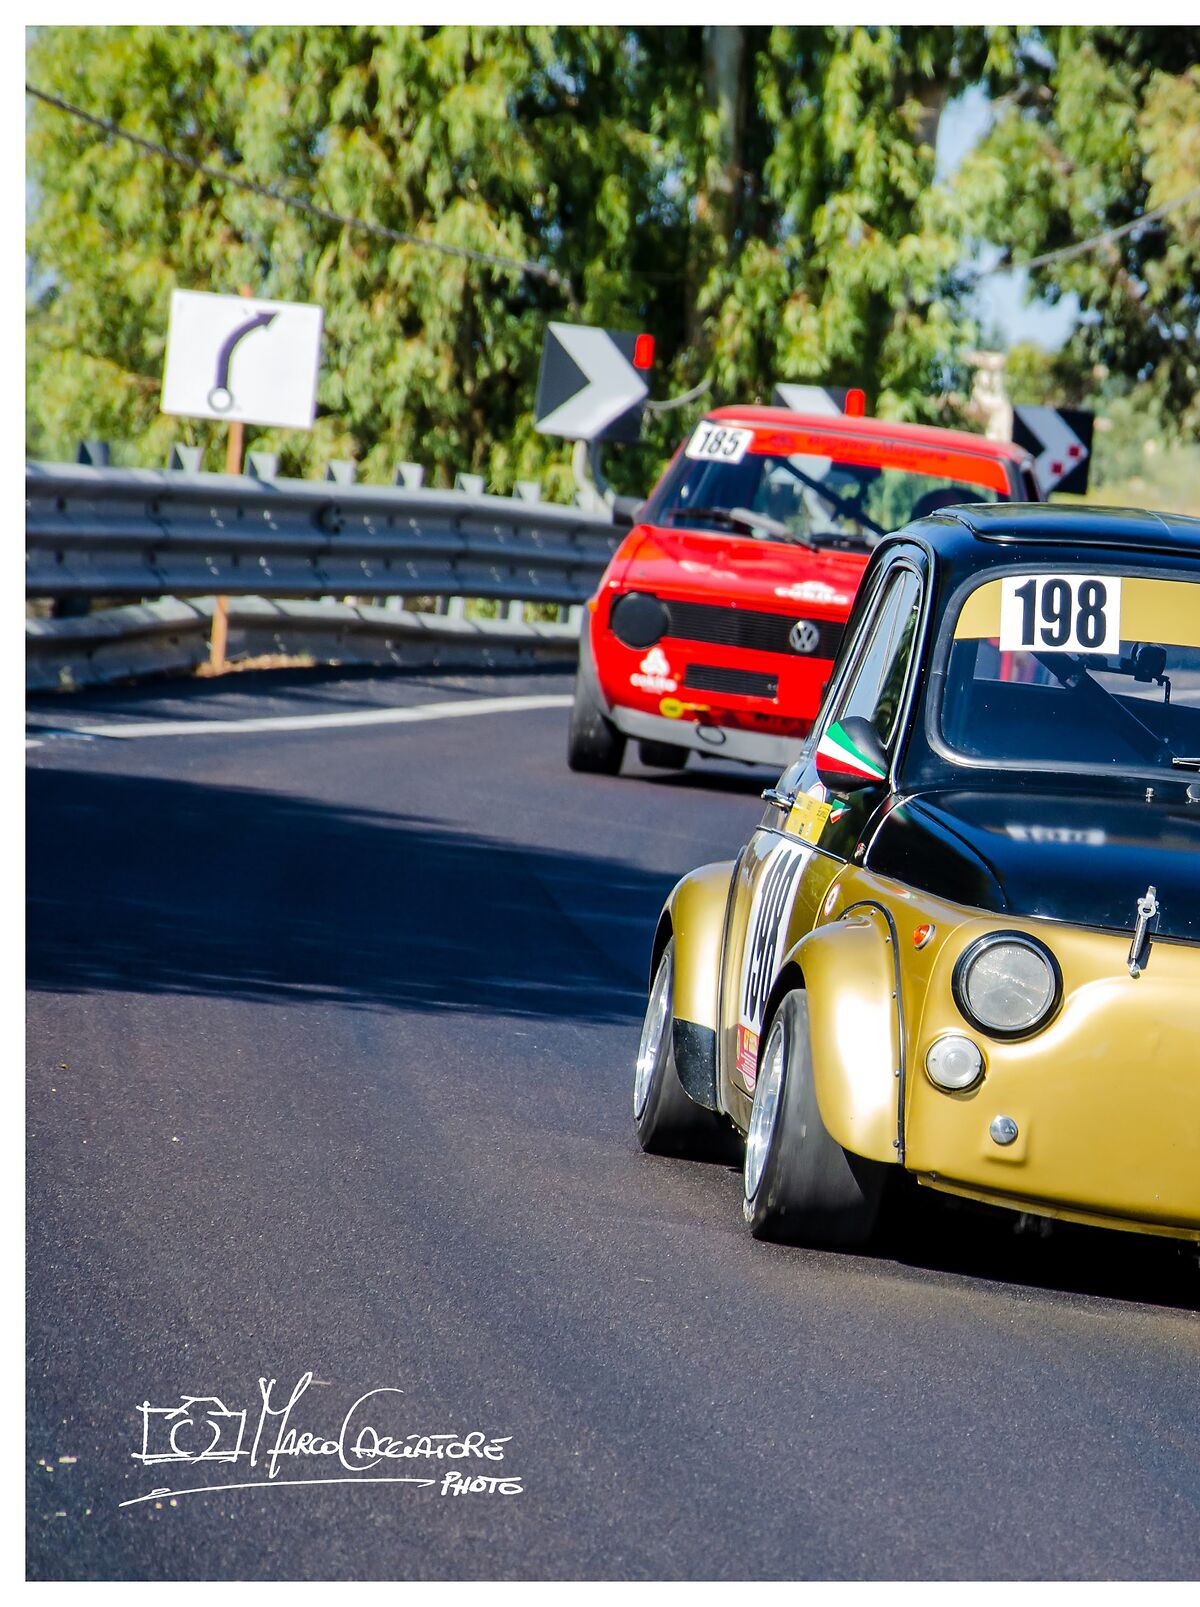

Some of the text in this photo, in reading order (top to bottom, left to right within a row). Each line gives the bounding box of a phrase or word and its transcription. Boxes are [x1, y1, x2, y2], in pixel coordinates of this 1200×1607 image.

[700, 429, 743, 456] 185
[1014, 578, 1107, 649] 198
[743, 849, 803, 1027] 198
